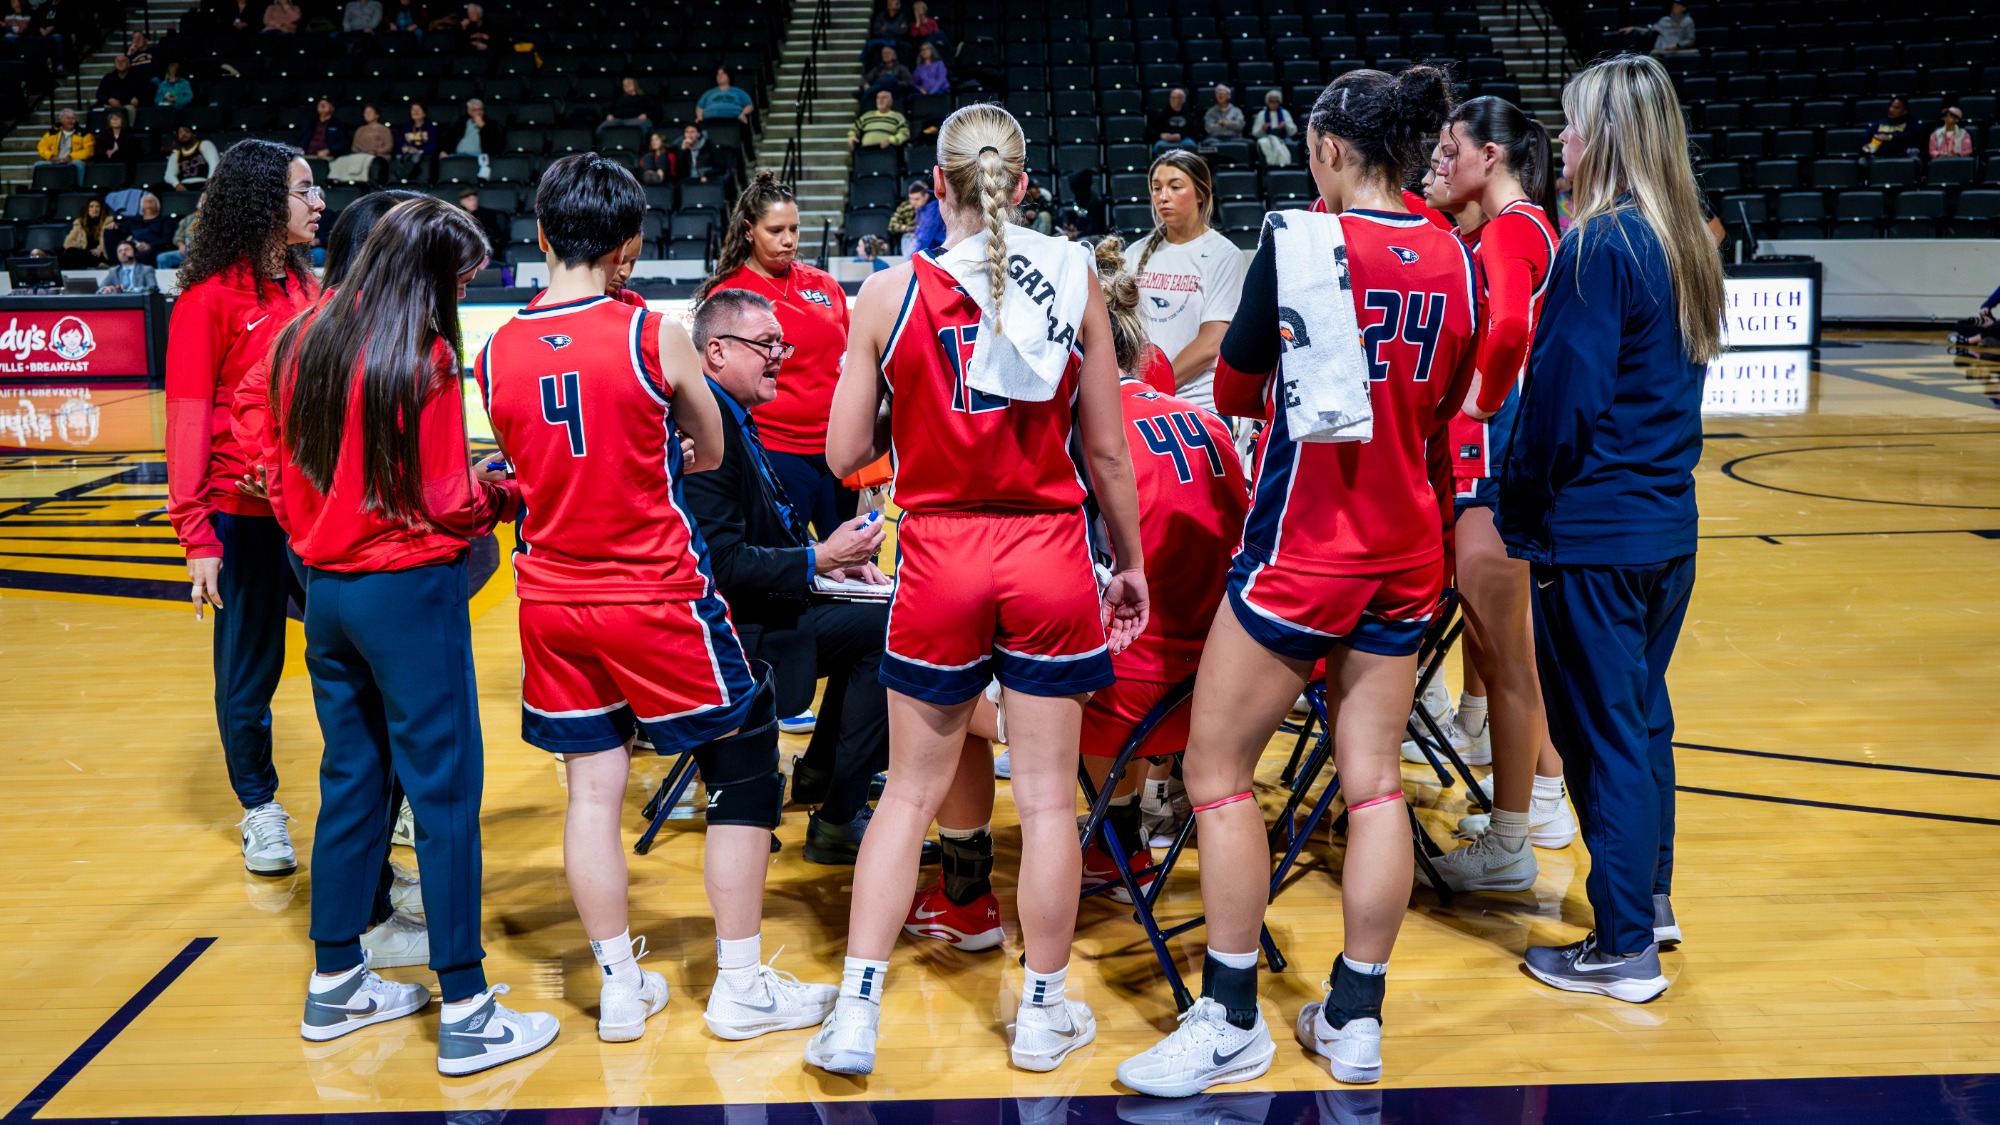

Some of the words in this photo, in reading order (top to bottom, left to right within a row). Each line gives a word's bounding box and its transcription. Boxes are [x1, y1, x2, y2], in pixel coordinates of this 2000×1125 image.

[1170, 273, 1201, 292] EAGLES
[1753, 291, 1801, 307] TECH
[1363, 289, 1447, 382] 24
[30, 362, 89, 372] BREAKFAST
[539, 371, 587, 458] 4
[1133, 411, 1226, 484] 44
